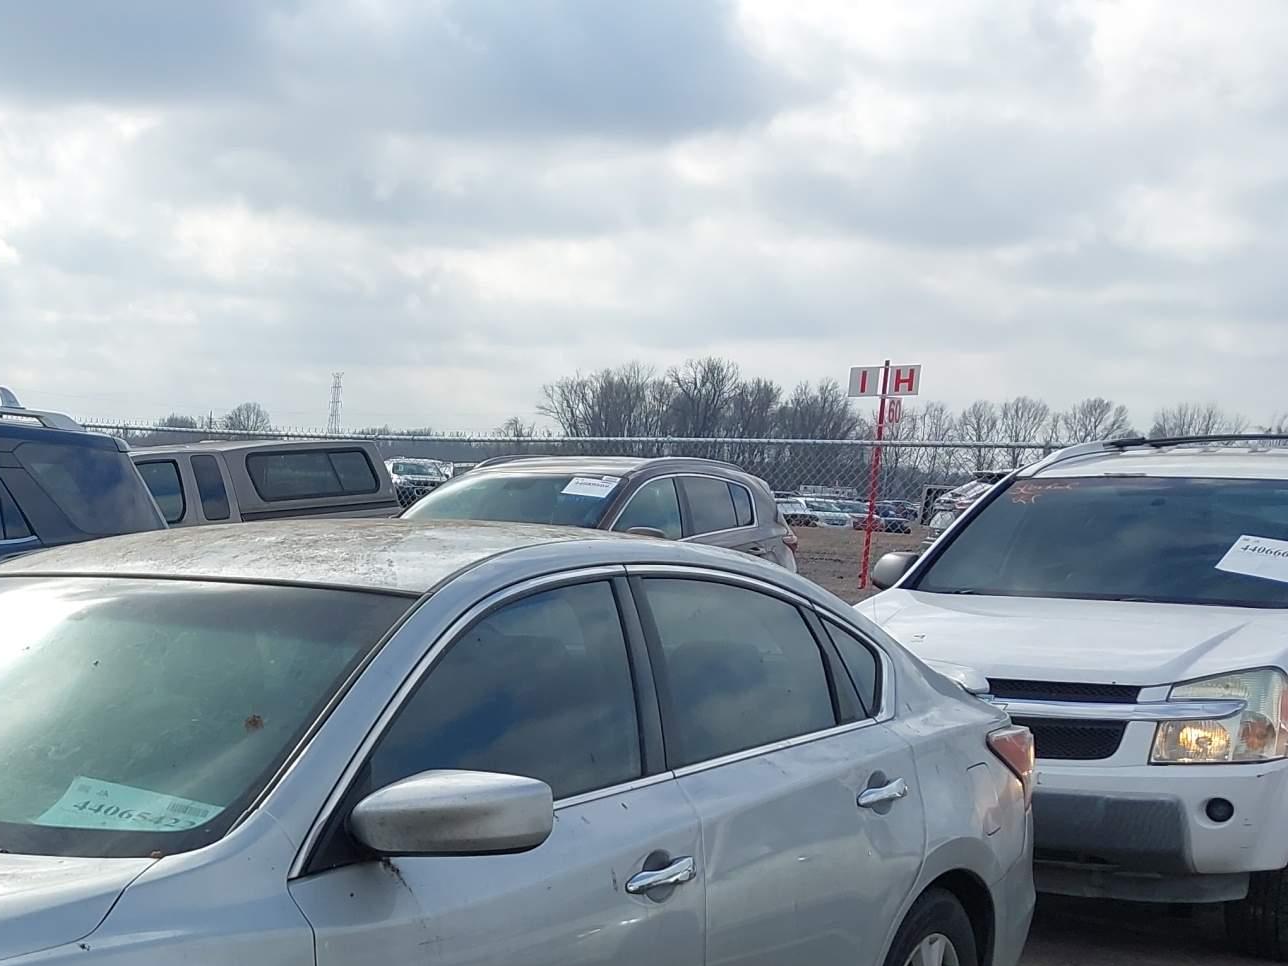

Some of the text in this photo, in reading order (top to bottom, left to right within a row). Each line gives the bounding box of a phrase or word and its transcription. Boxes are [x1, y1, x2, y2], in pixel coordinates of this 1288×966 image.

[860, 368, 915, 394] I H
[888, 399, 902, 424] 60
